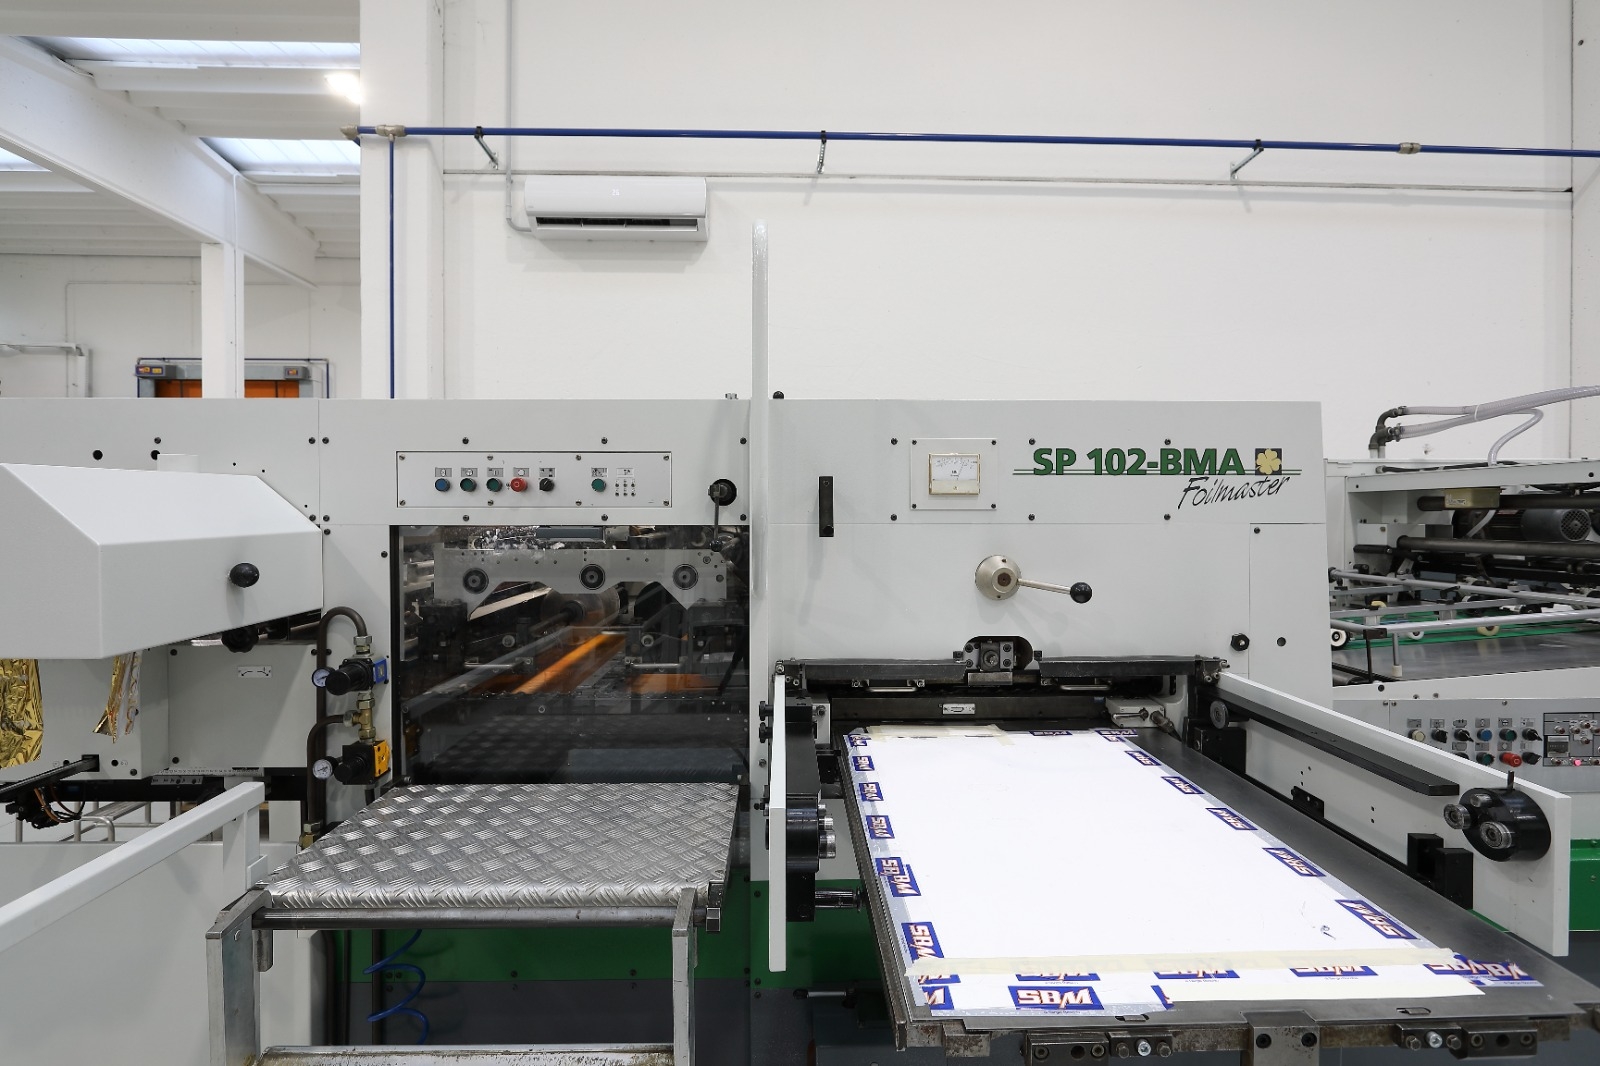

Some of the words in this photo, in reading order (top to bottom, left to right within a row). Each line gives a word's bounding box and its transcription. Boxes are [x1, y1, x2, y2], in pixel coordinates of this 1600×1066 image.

[1033, 448, 1077, 476] SP
[1086, 448, 1246, 476] 102-BMA
[1177, 476, 1291, 510] Foilmaster
[1340, 901, 1408, 937] SBM
[1016, 987, 1094, 1009] SBM
